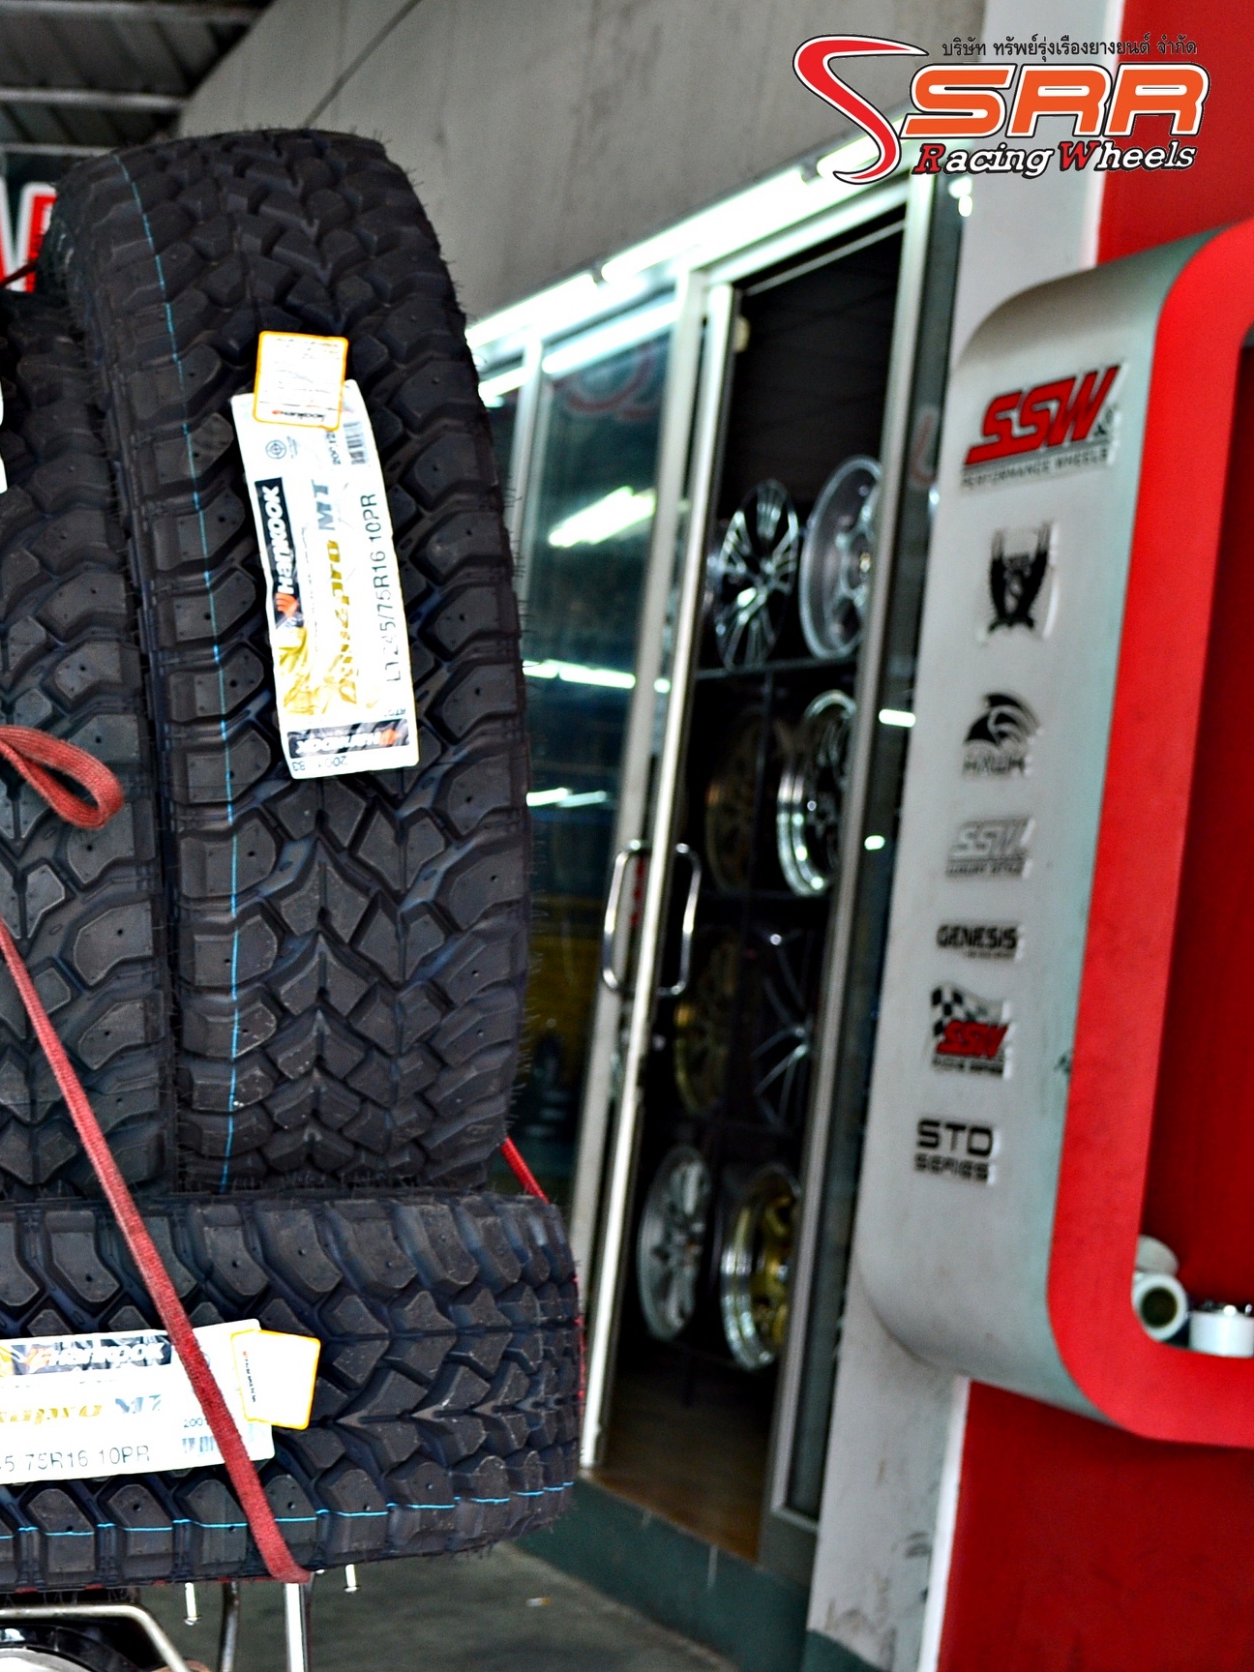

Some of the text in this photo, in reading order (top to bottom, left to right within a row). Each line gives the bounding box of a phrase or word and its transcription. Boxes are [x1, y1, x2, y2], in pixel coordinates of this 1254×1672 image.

[963, 364, 1121, 466] SSW
[311, 478, 336, 531] MT
[359, 492, 382, 542] 10PR
[913, 1152, 989, 1182] SERIES
[98, 1444, 150, 1465] 10PR
